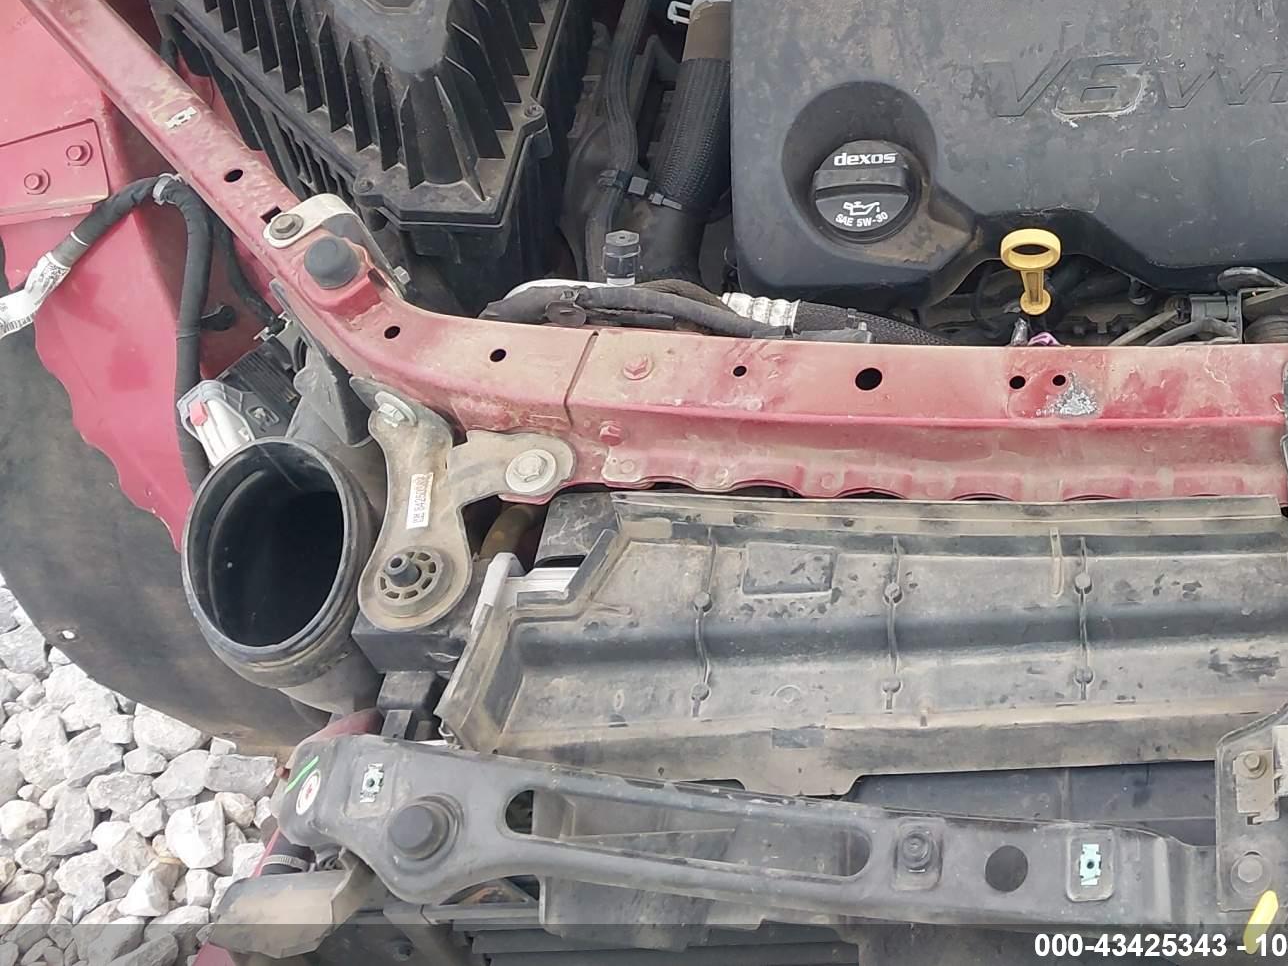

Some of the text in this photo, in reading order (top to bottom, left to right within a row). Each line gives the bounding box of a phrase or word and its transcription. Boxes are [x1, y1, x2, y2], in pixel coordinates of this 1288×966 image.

[982, 52, 1146, 119] V6
[833, 152, 898, 167] dexos
[835, 211, 889, 227] SAE 5W-30
